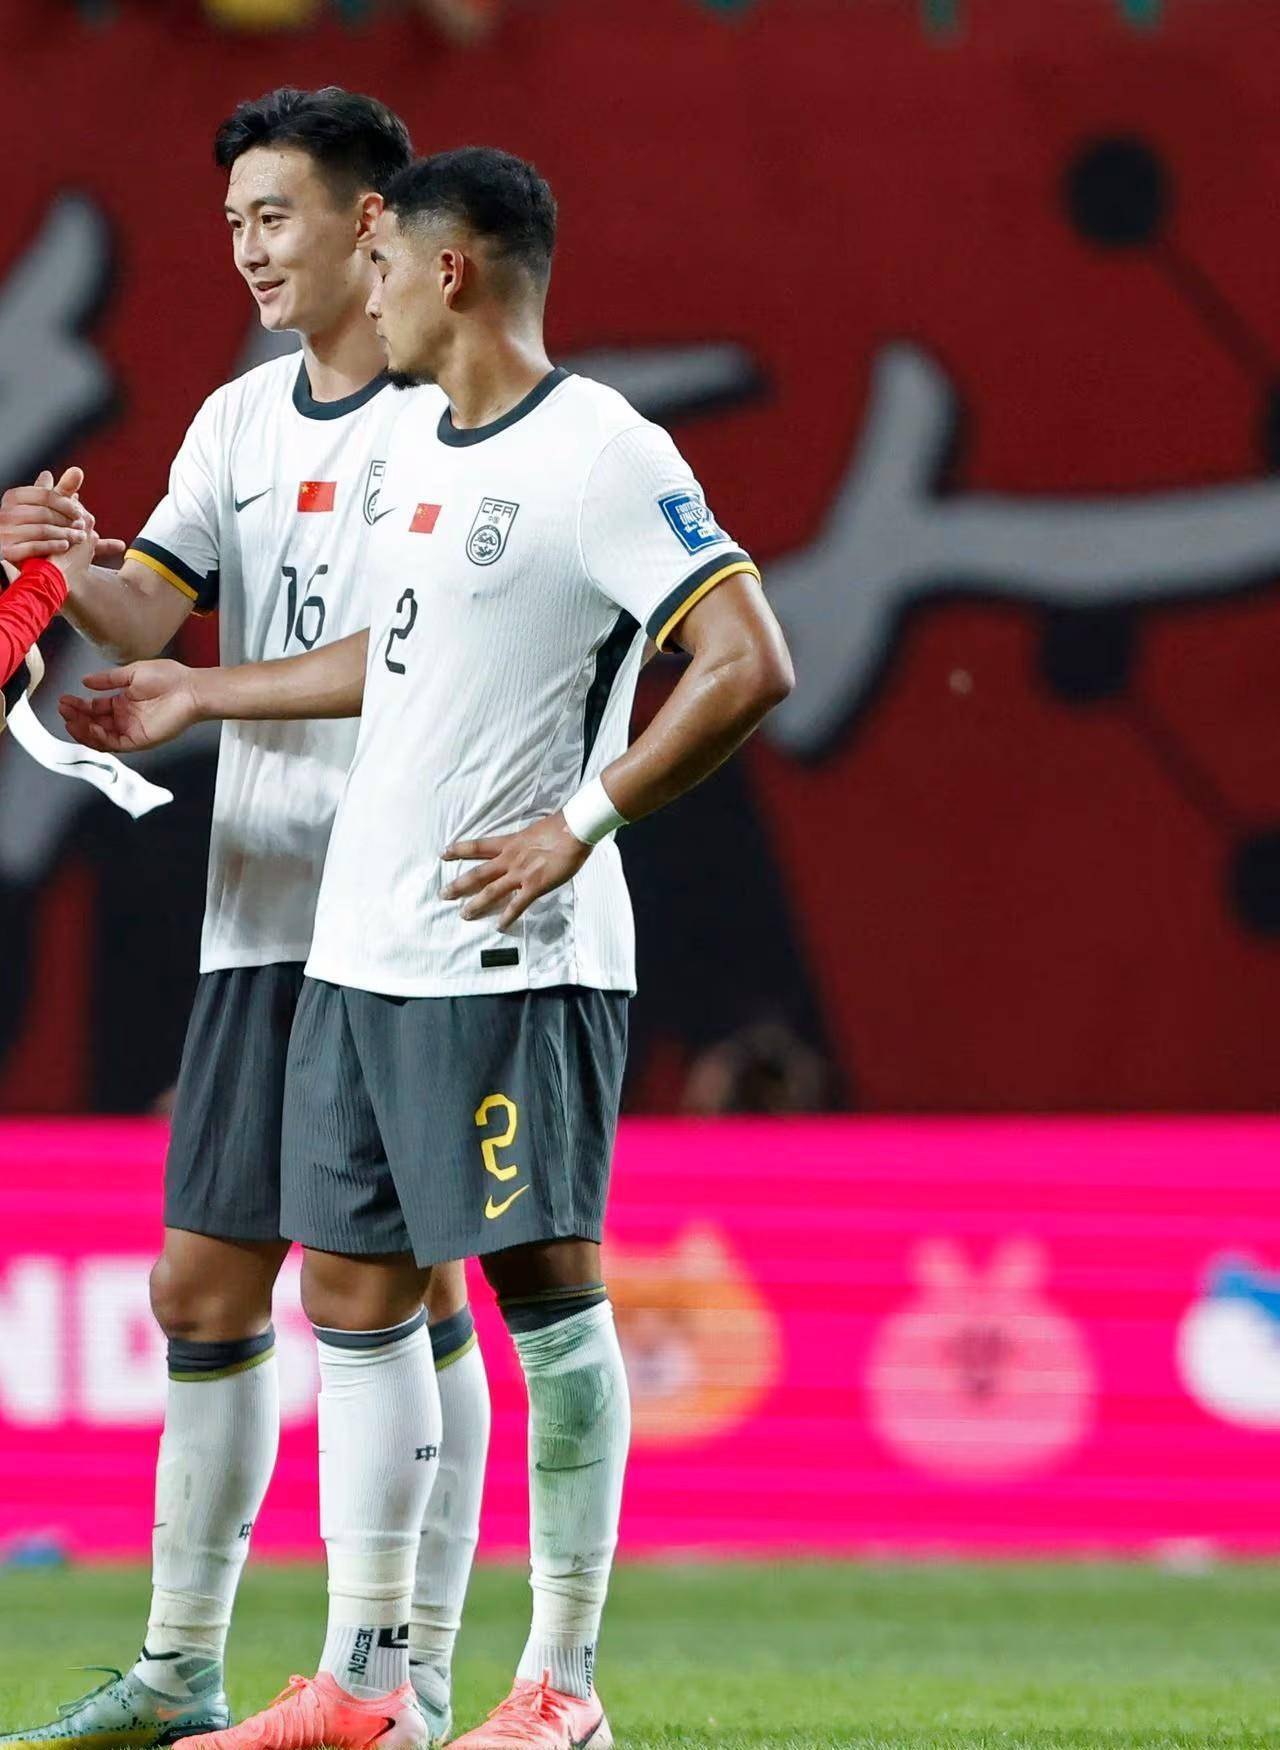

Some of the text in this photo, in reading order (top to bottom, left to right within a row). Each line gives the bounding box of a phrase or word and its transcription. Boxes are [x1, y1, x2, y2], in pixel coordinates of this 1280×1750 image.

[481, 502, 513, 518] CFA
[281, 564, 329, 653] 16
[385, 588, 418, 675] 2
[475, 1093, 518, 1182] 2
